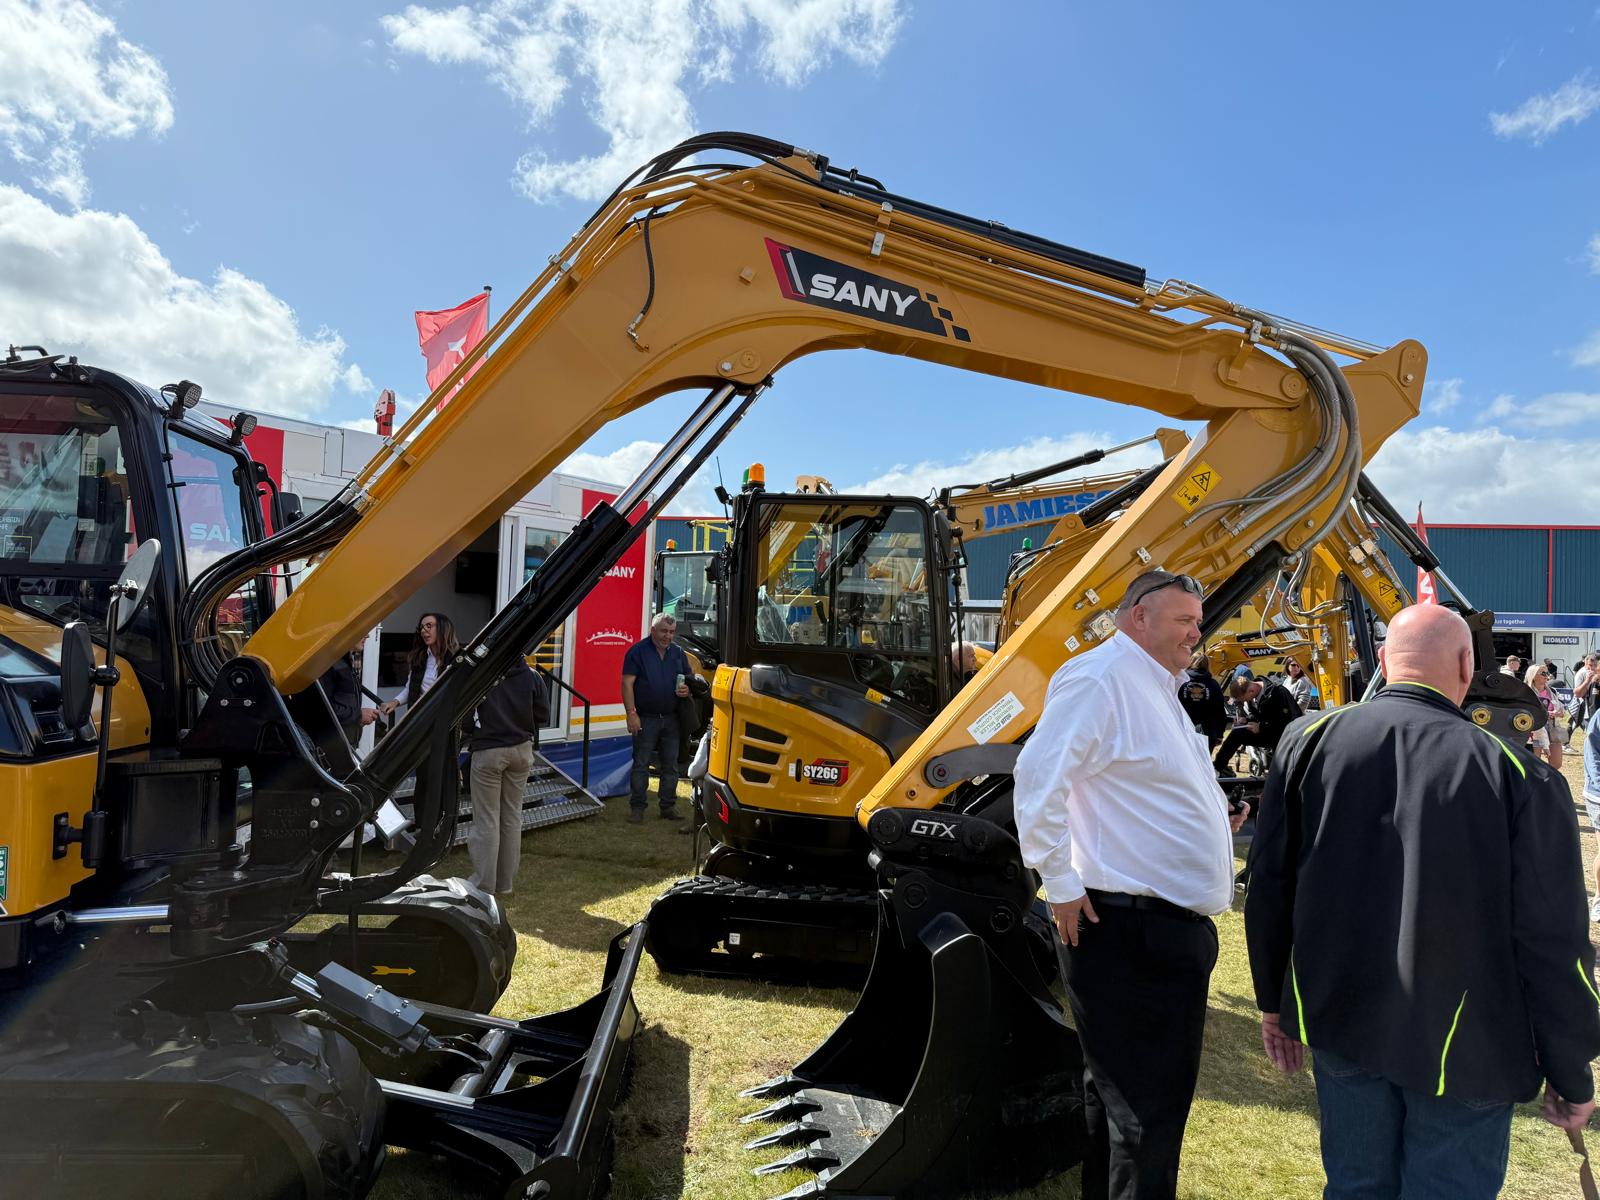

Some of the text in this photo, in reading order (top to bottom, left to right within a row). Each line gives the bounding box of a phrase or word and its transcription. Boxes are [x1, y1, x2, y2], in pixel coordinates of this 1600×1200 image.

[809, 273, 918, 317] SANY
[1545, 636, 1577, 644] KOMATSU
[1248, 648, 1272, 656] SANY
[803, 765, 839, 780] SY26C
[910, 819, 958, 839] GTX
